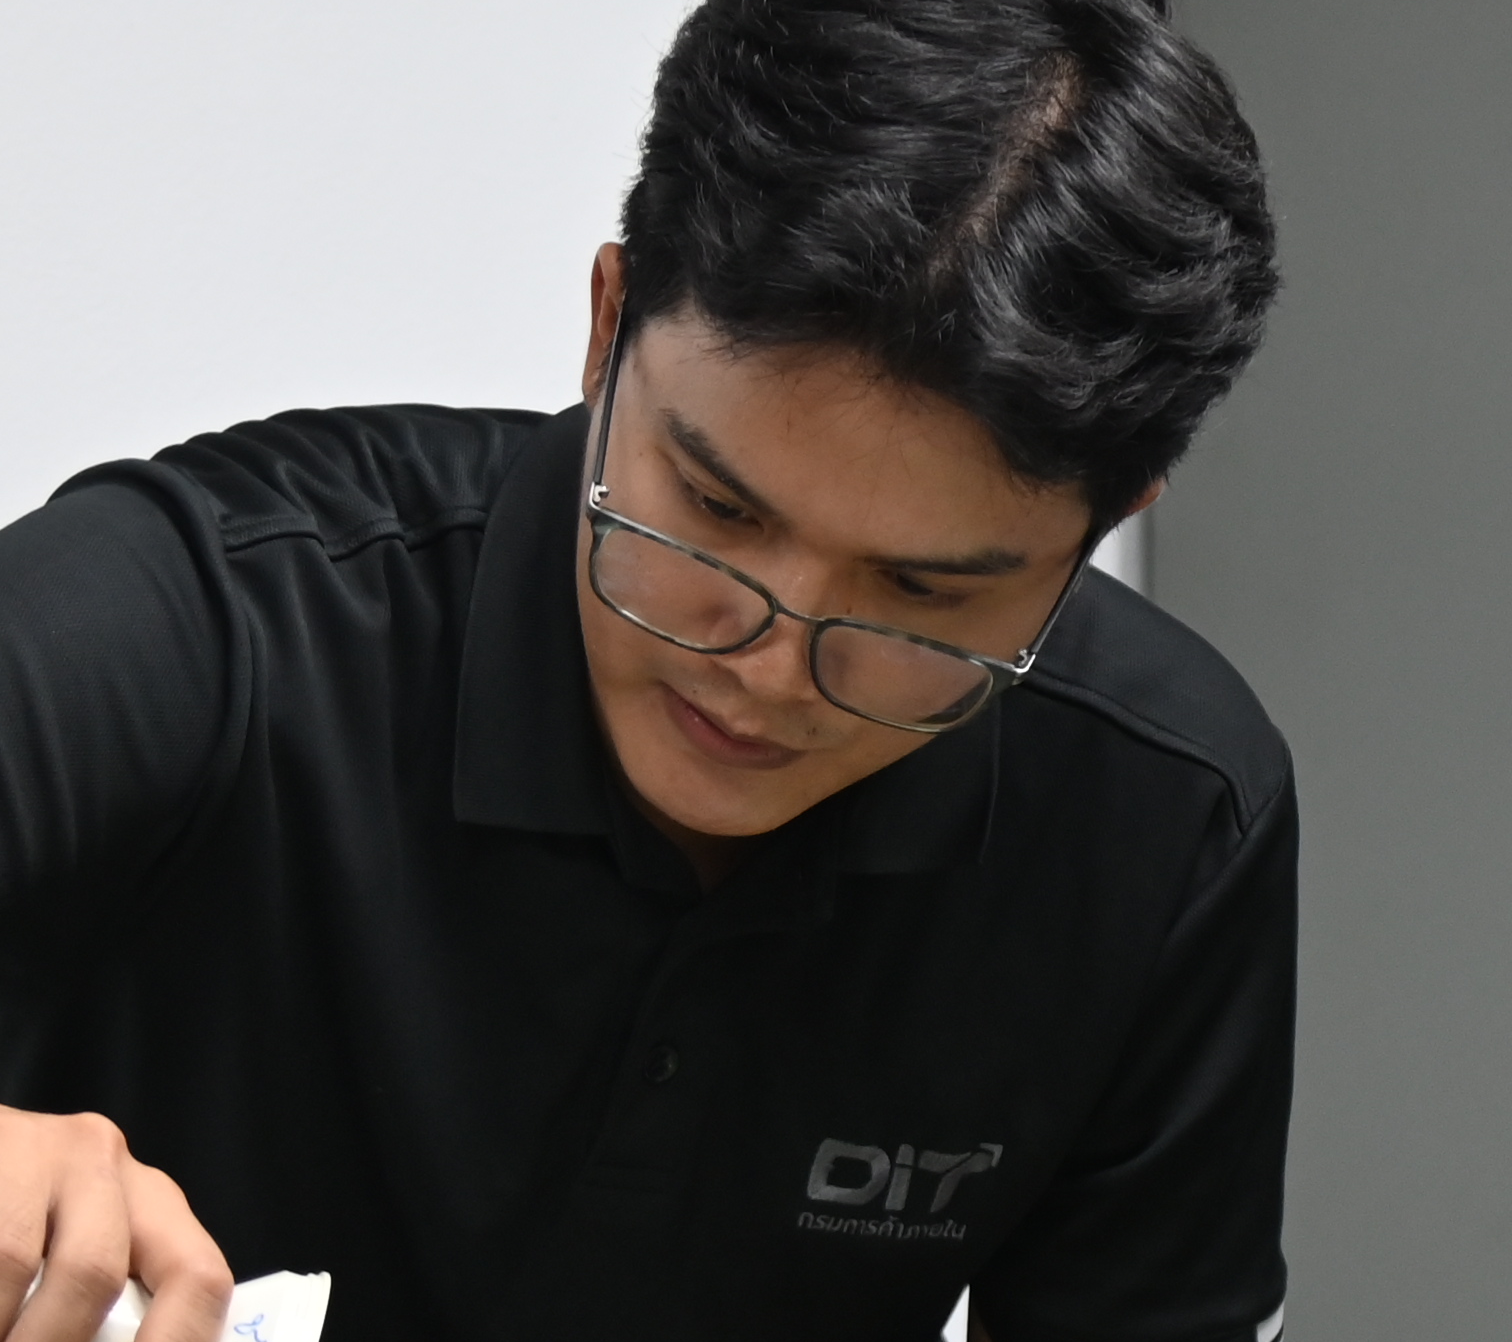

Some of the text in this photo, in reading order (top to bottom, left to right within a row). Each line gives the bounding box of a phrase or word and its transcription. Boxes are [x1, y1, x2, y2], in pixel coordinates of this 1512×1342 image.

[797, 1211, 967, 1241] กรมการค้าภายใน
